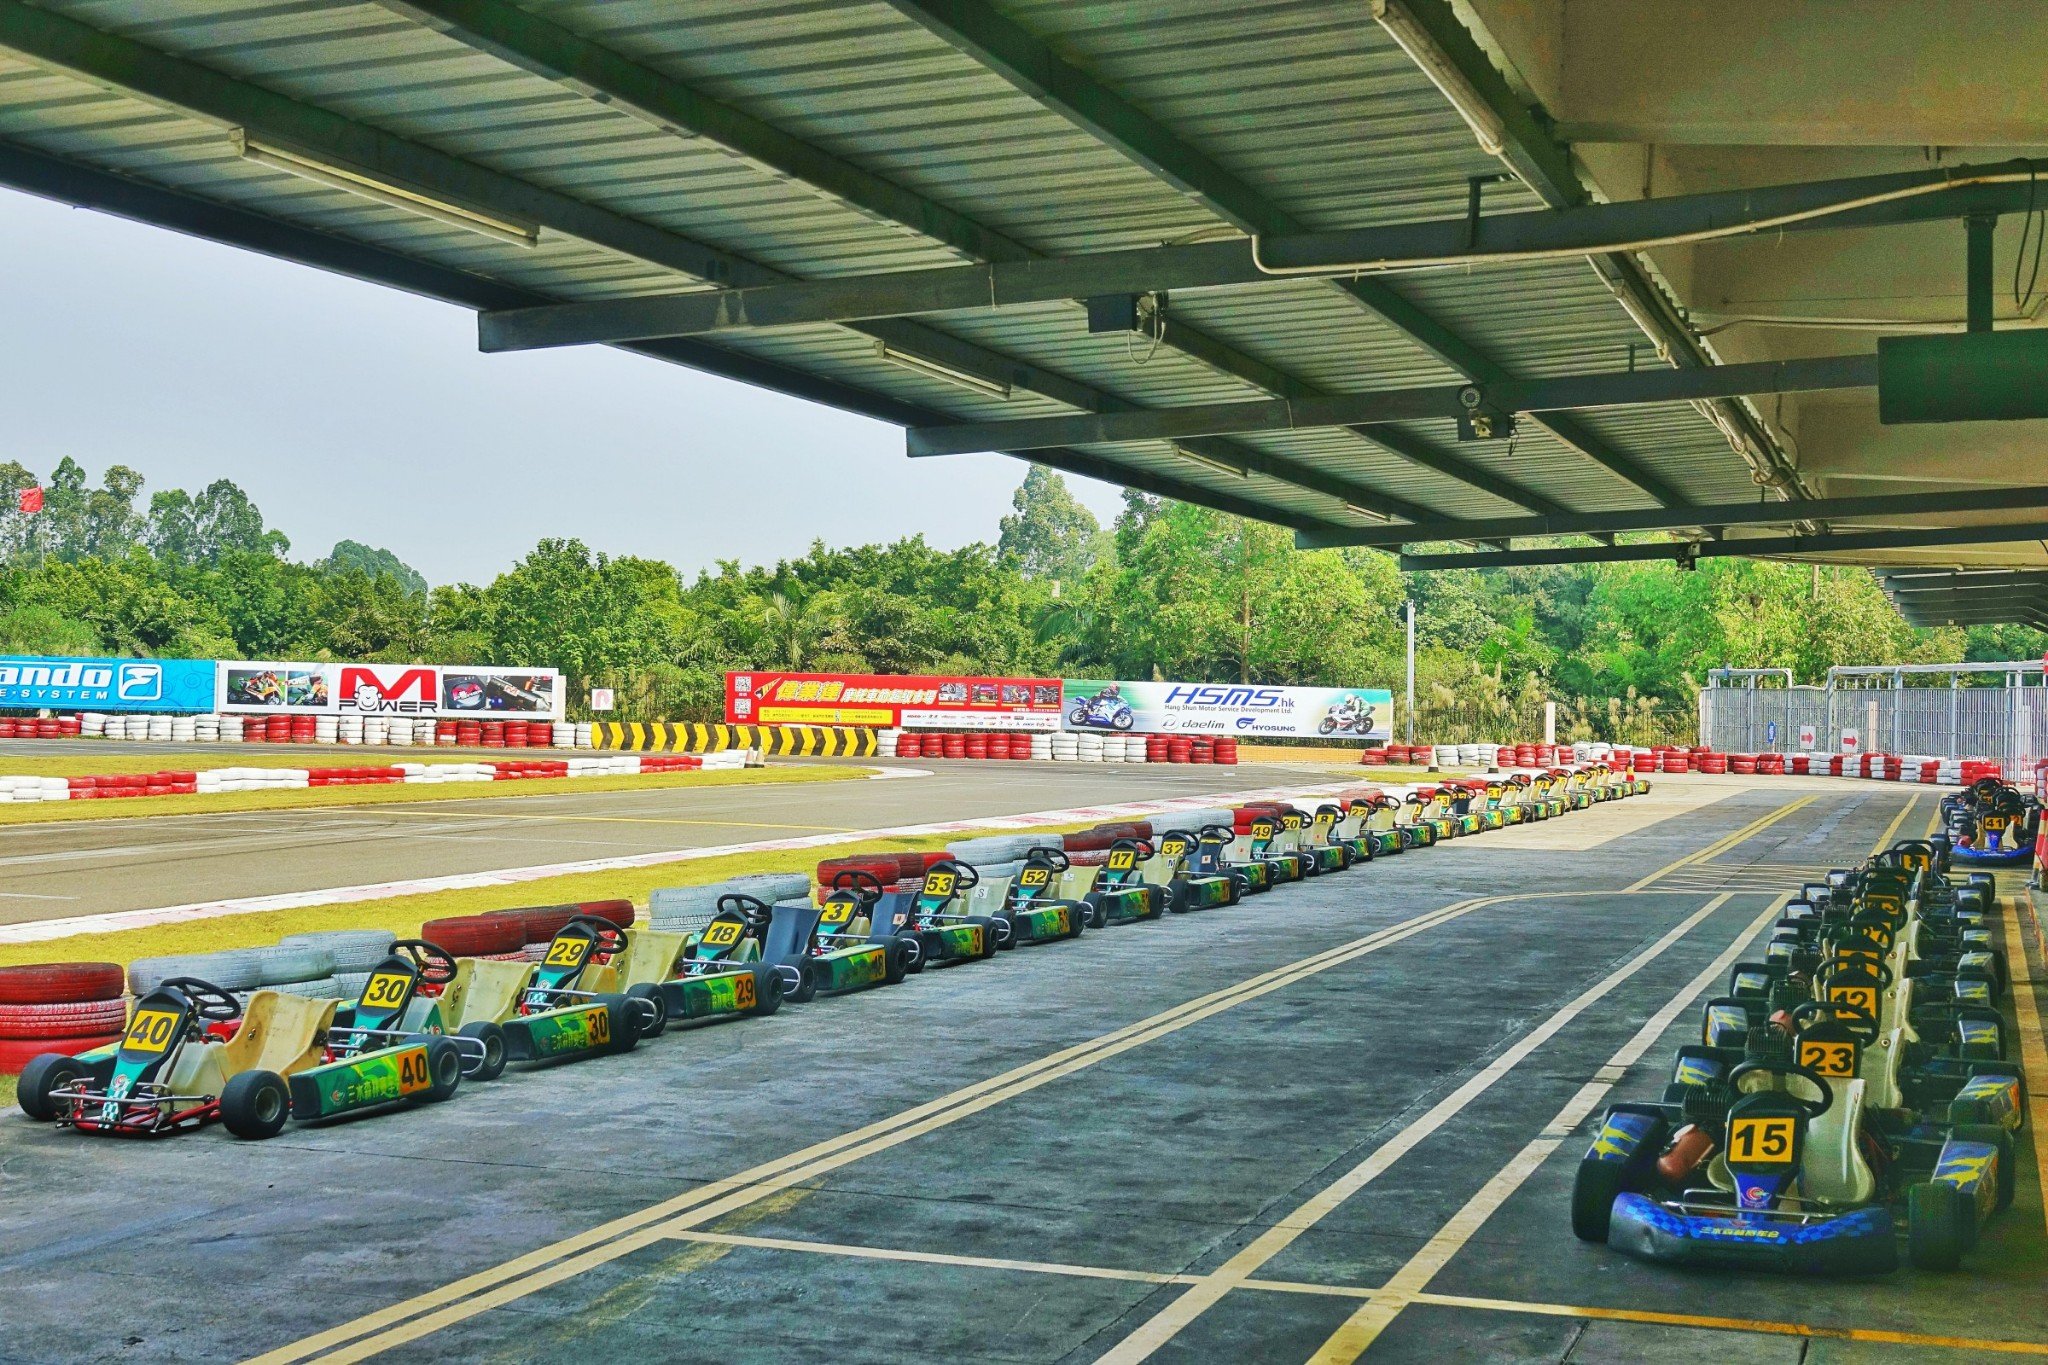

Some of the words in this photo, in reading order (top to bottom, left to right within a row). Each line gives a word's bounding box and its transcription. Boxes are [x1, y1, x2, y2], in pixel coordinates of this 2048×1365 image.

[20, 689, 108, 700] SYSTEM
[1181, 719, 1225, 729] daelim
[1252, 724, 1296, 732] HYOSUNG
[1253, 826, 1271, 838] 49
[1283, 818, 1299, 830] 20
[1986, 819, 2004, 828] 41
[1112, 852, 1132, 866] 17
[926, 876, 953, 893] 53
[1025, 870, 1047, 884] 52
[827, 903, 845, 921] 3
[711, 926, 736, 942] 18
[549, 942, 585, 962] 29
[369, 978, 406, 1003] 30
[736, 979, 754, 1004] 29
[130, 1016, 173, 1045] 40
[588, 1011, 608, 1041] 30
[1804, 1046, 1853, 1073] 23
[401, 1053, 428, 1087] 40
[1735, 1124, 1788, 1156] 15
